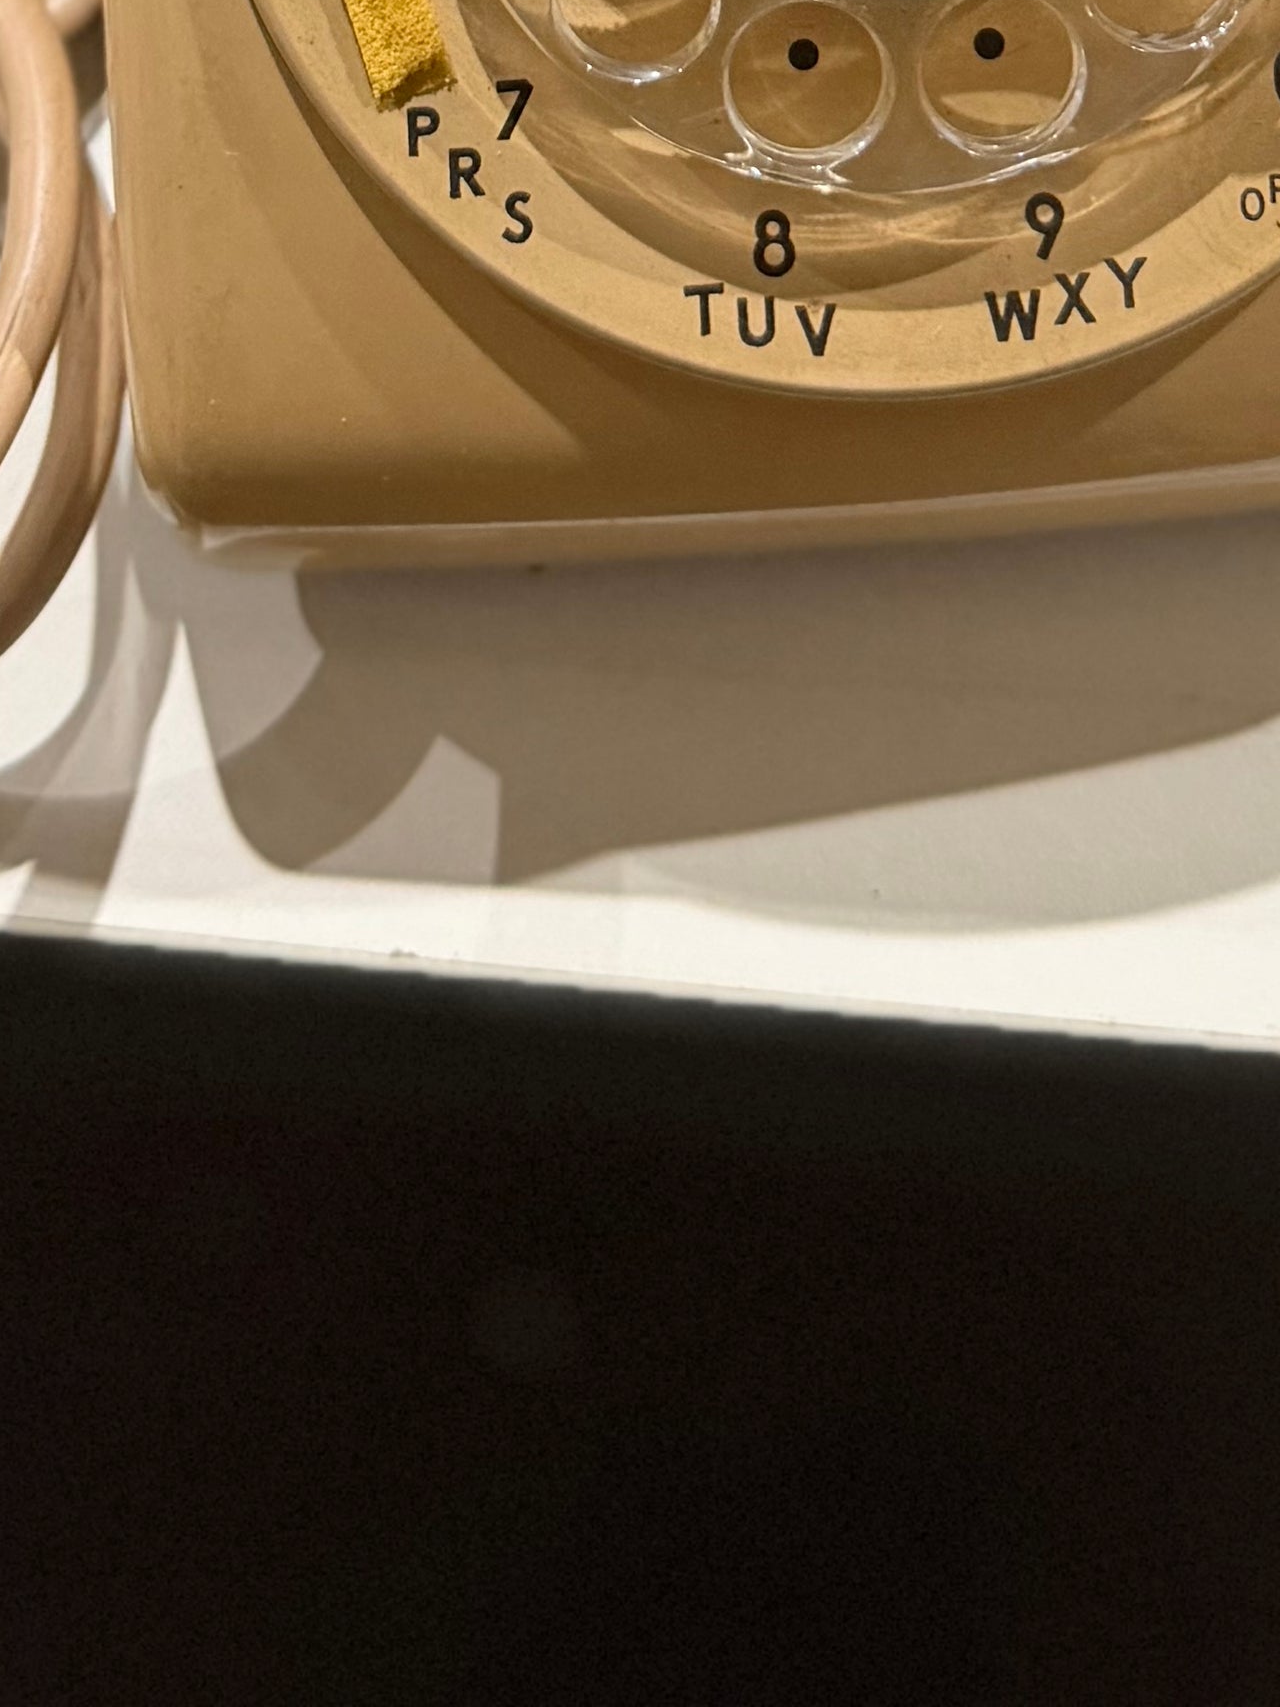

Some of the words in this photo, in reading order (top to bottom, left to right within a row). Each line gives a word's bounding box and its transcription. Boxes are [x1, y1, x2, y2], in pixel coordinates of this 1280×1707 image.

[495, 78, 534, 141] 7
[752, 208, 797, 279] 8
[1024, 191, 1066, 261] 9
[683, 282, 838, 358] TUV
[983, 256, 1148, 343] WXY
